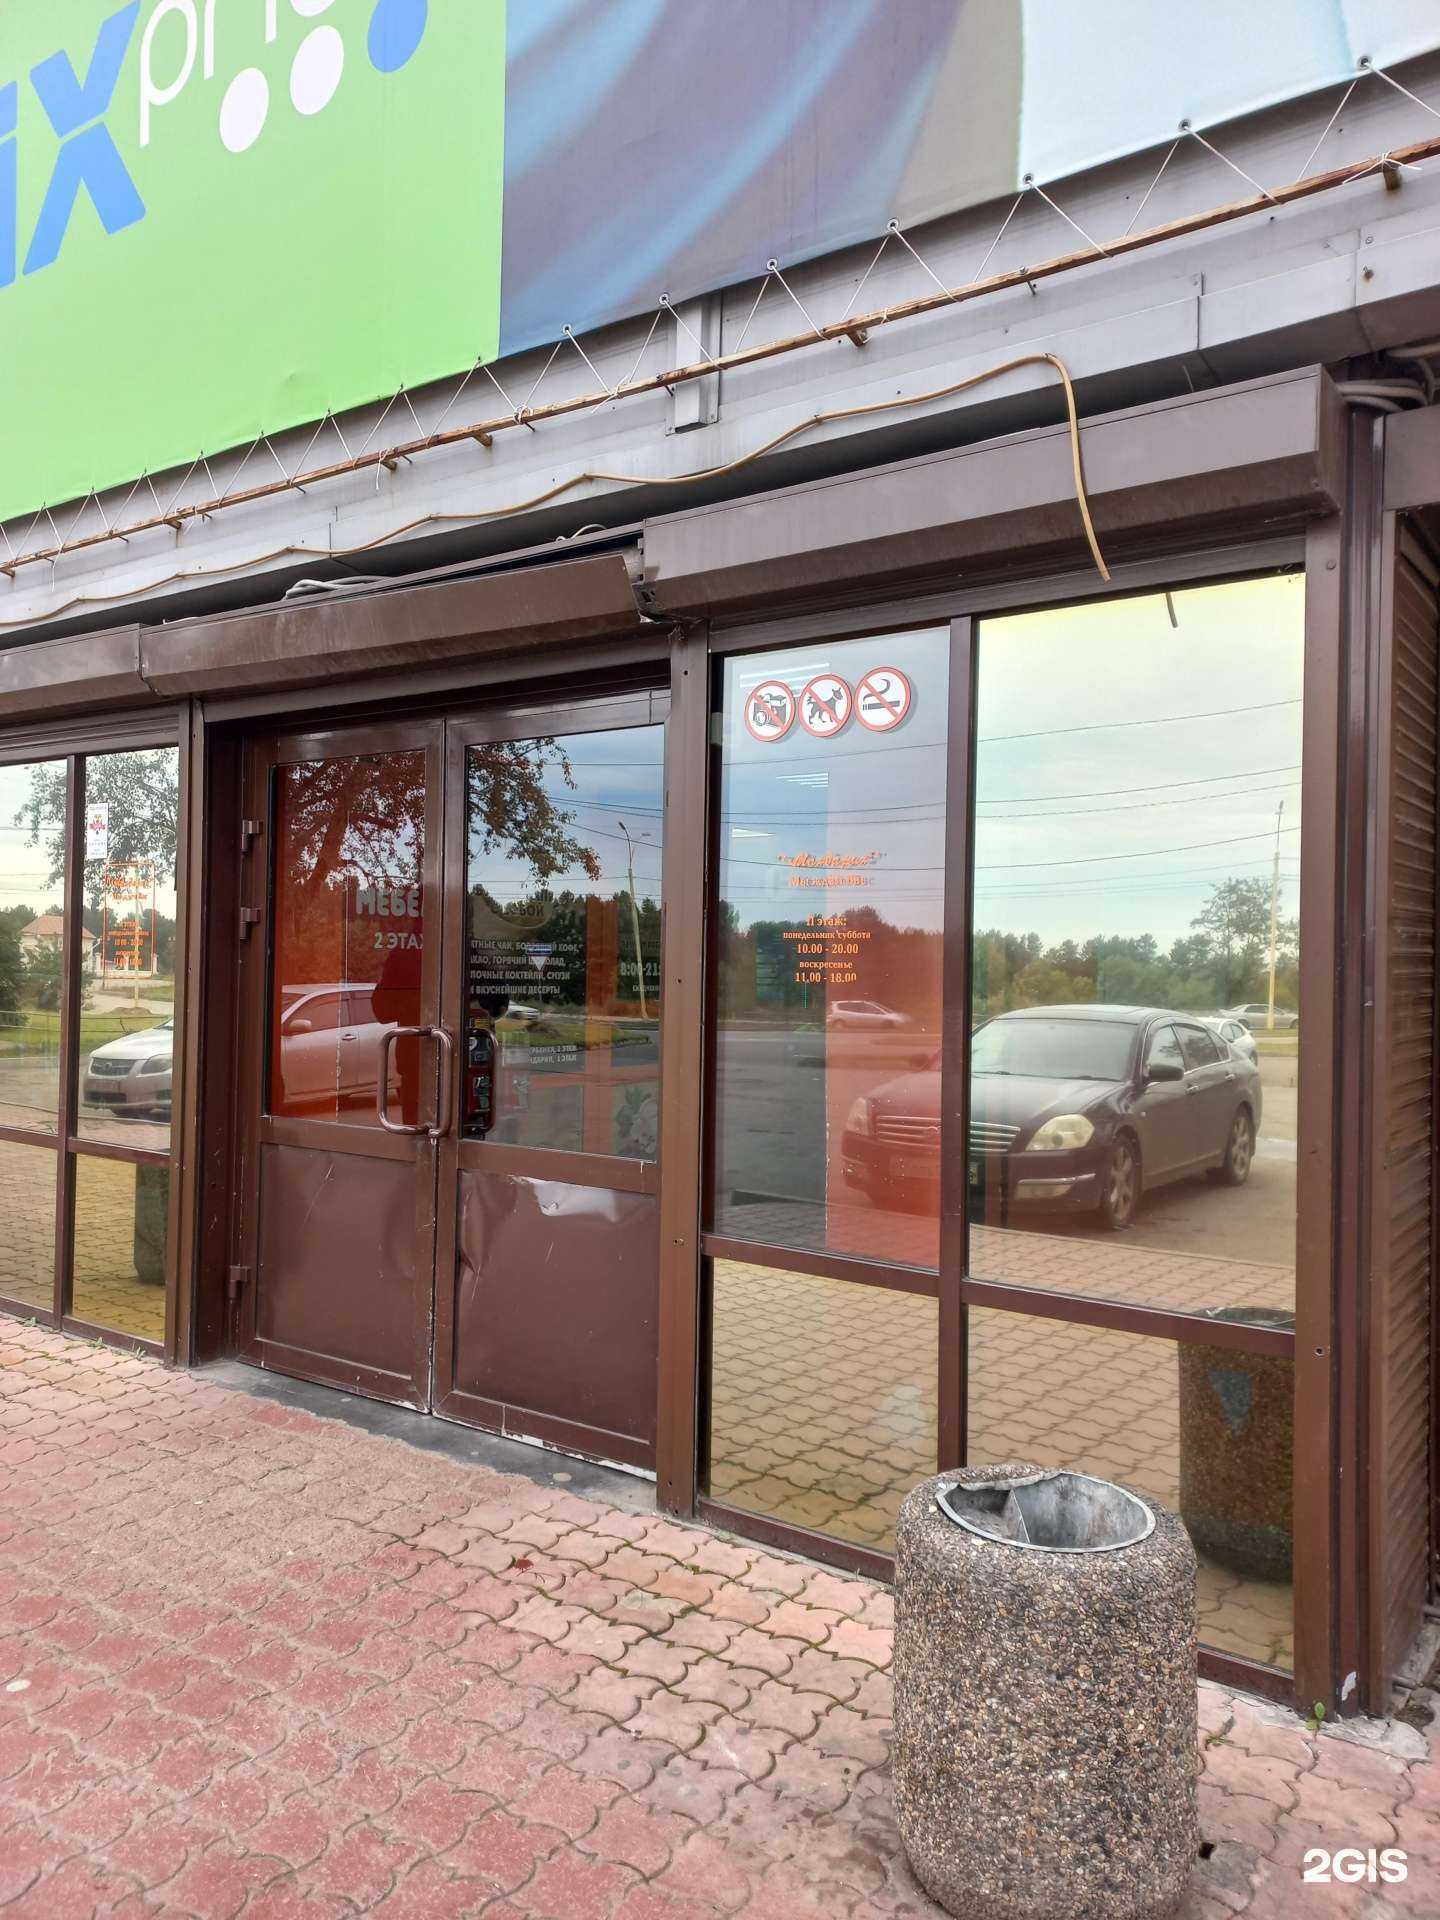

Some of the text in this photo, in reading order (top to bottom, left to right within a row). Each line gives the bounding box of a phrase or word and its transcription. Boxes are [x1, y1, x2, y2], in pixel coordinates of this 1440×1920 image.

[356, 887, 424, 918] МЕБЕ
[374, 931, 424, 949] 2 ЭТА
[797, 943, 822, 954] 10.00
[831, 943, 859, 954] 20.00
[794, 972, 821, 983] 11.00
[830, 972, 857, 983] 18.00
